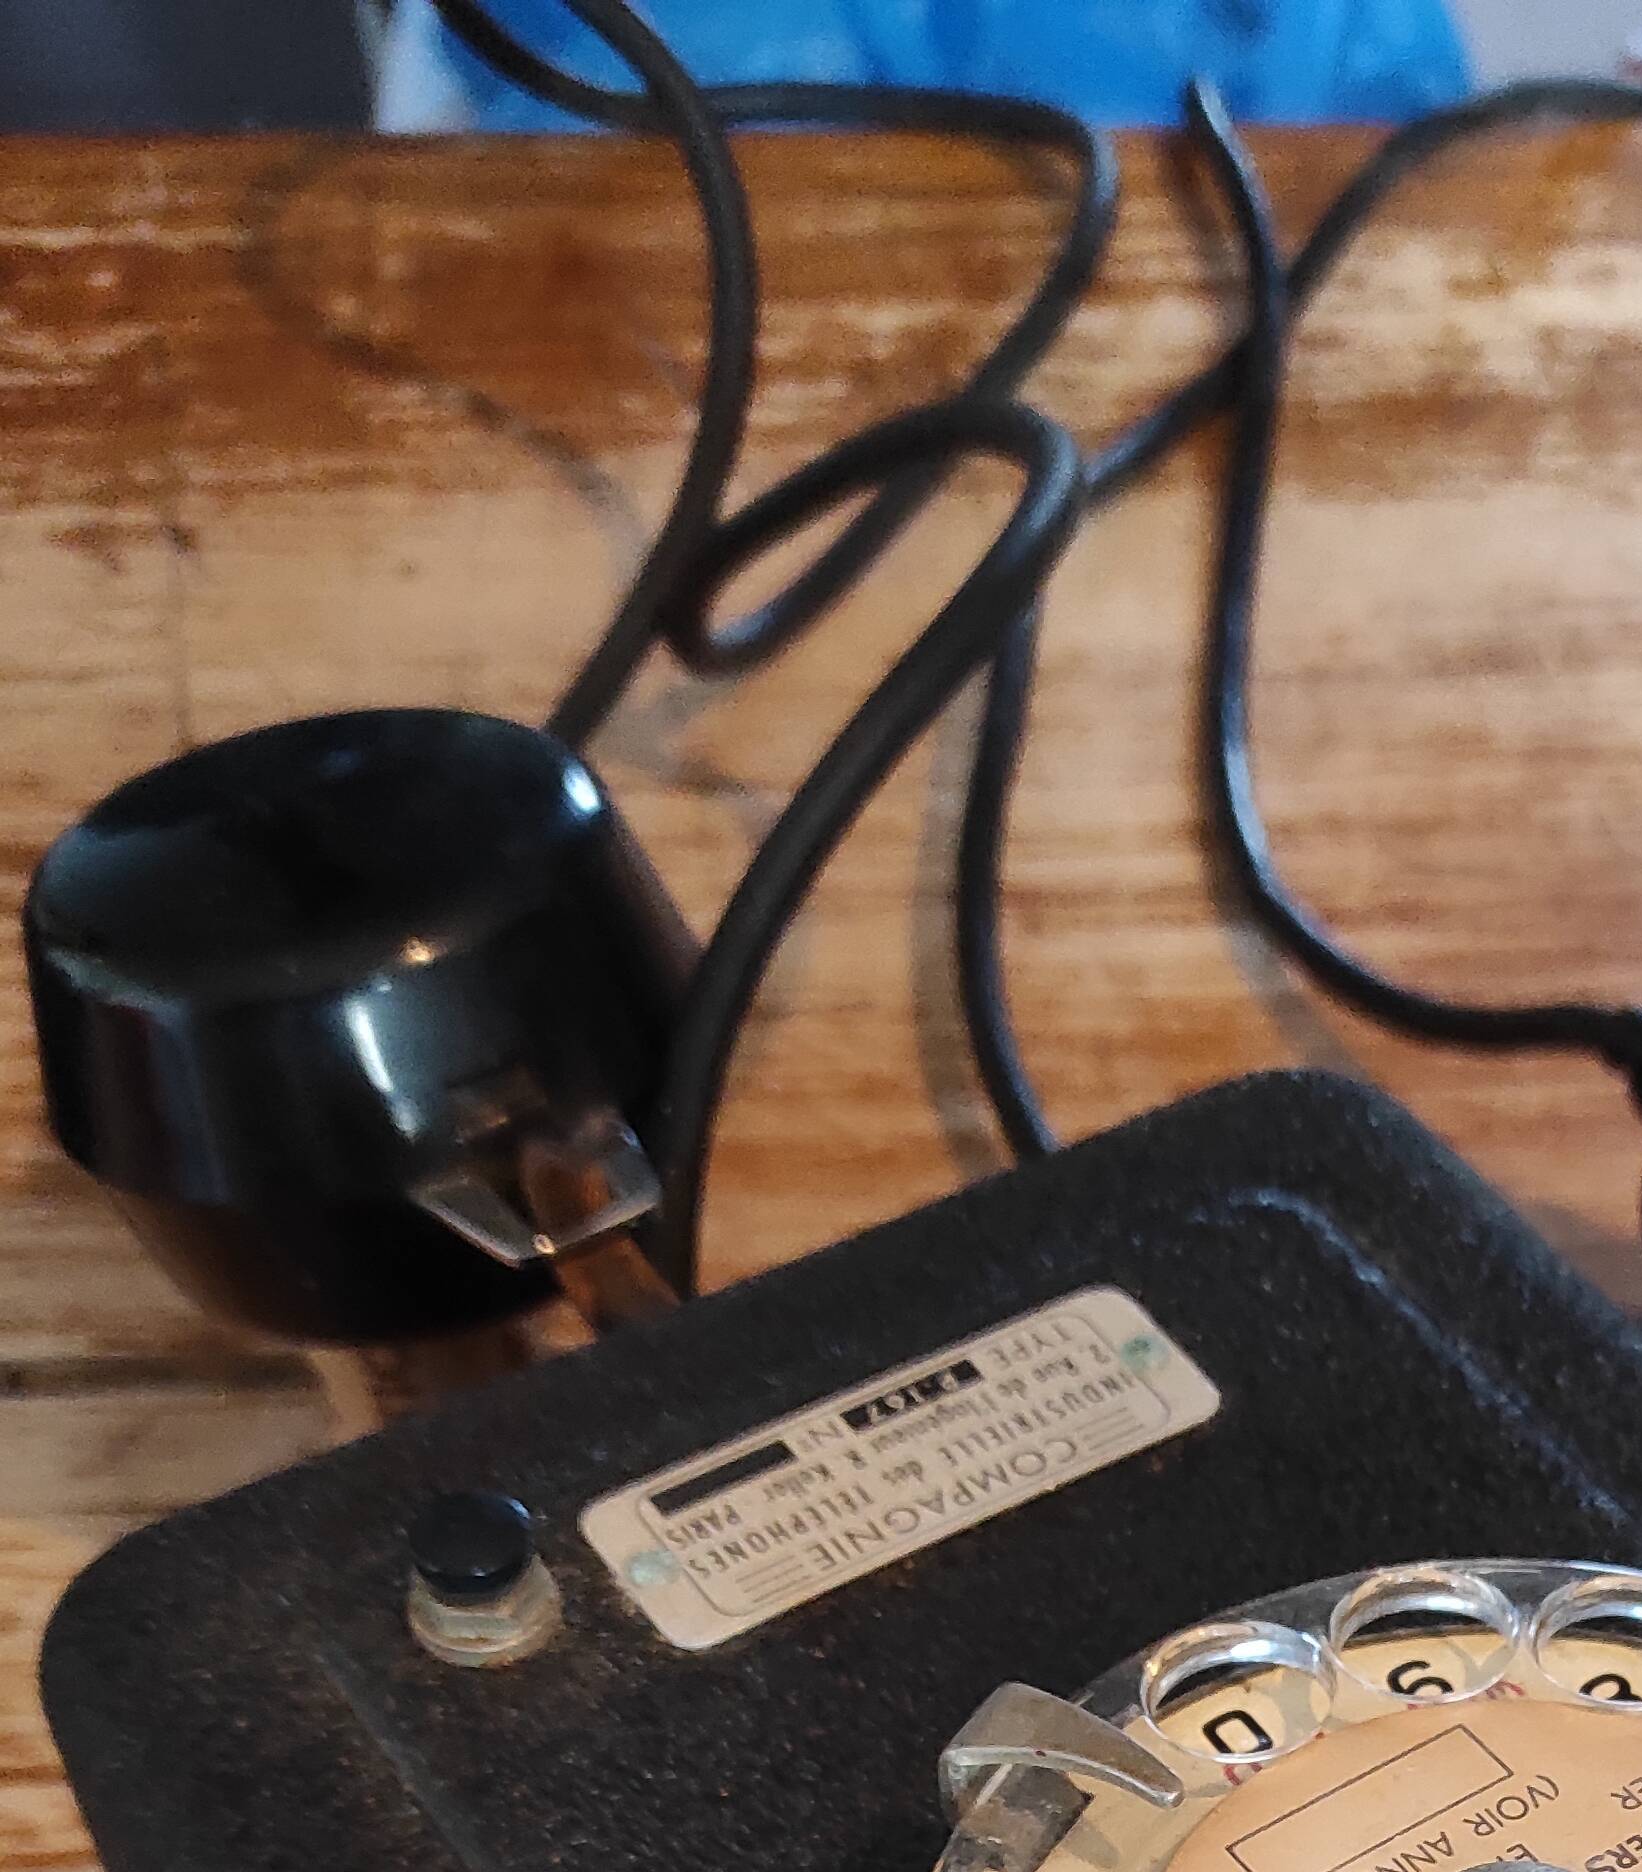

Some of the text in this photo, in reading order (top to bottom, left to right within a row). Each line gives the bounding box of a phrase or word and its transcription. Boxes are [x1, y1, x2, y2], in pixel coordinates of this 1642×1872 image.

[989, 1320, 1073, 1370] TYPE
[1031, 1354, 1077, 1389] Rue
[937, 1370, 1134, 1466] INDUSTRIELLE
[882, 1459, 923, 1490] des
[665, 1503, 740, 1549] PARIS
[803, 1436, 1079, 1572] COMPAGNIE
[1462, 1774, 1560, 1838] (VOIR
